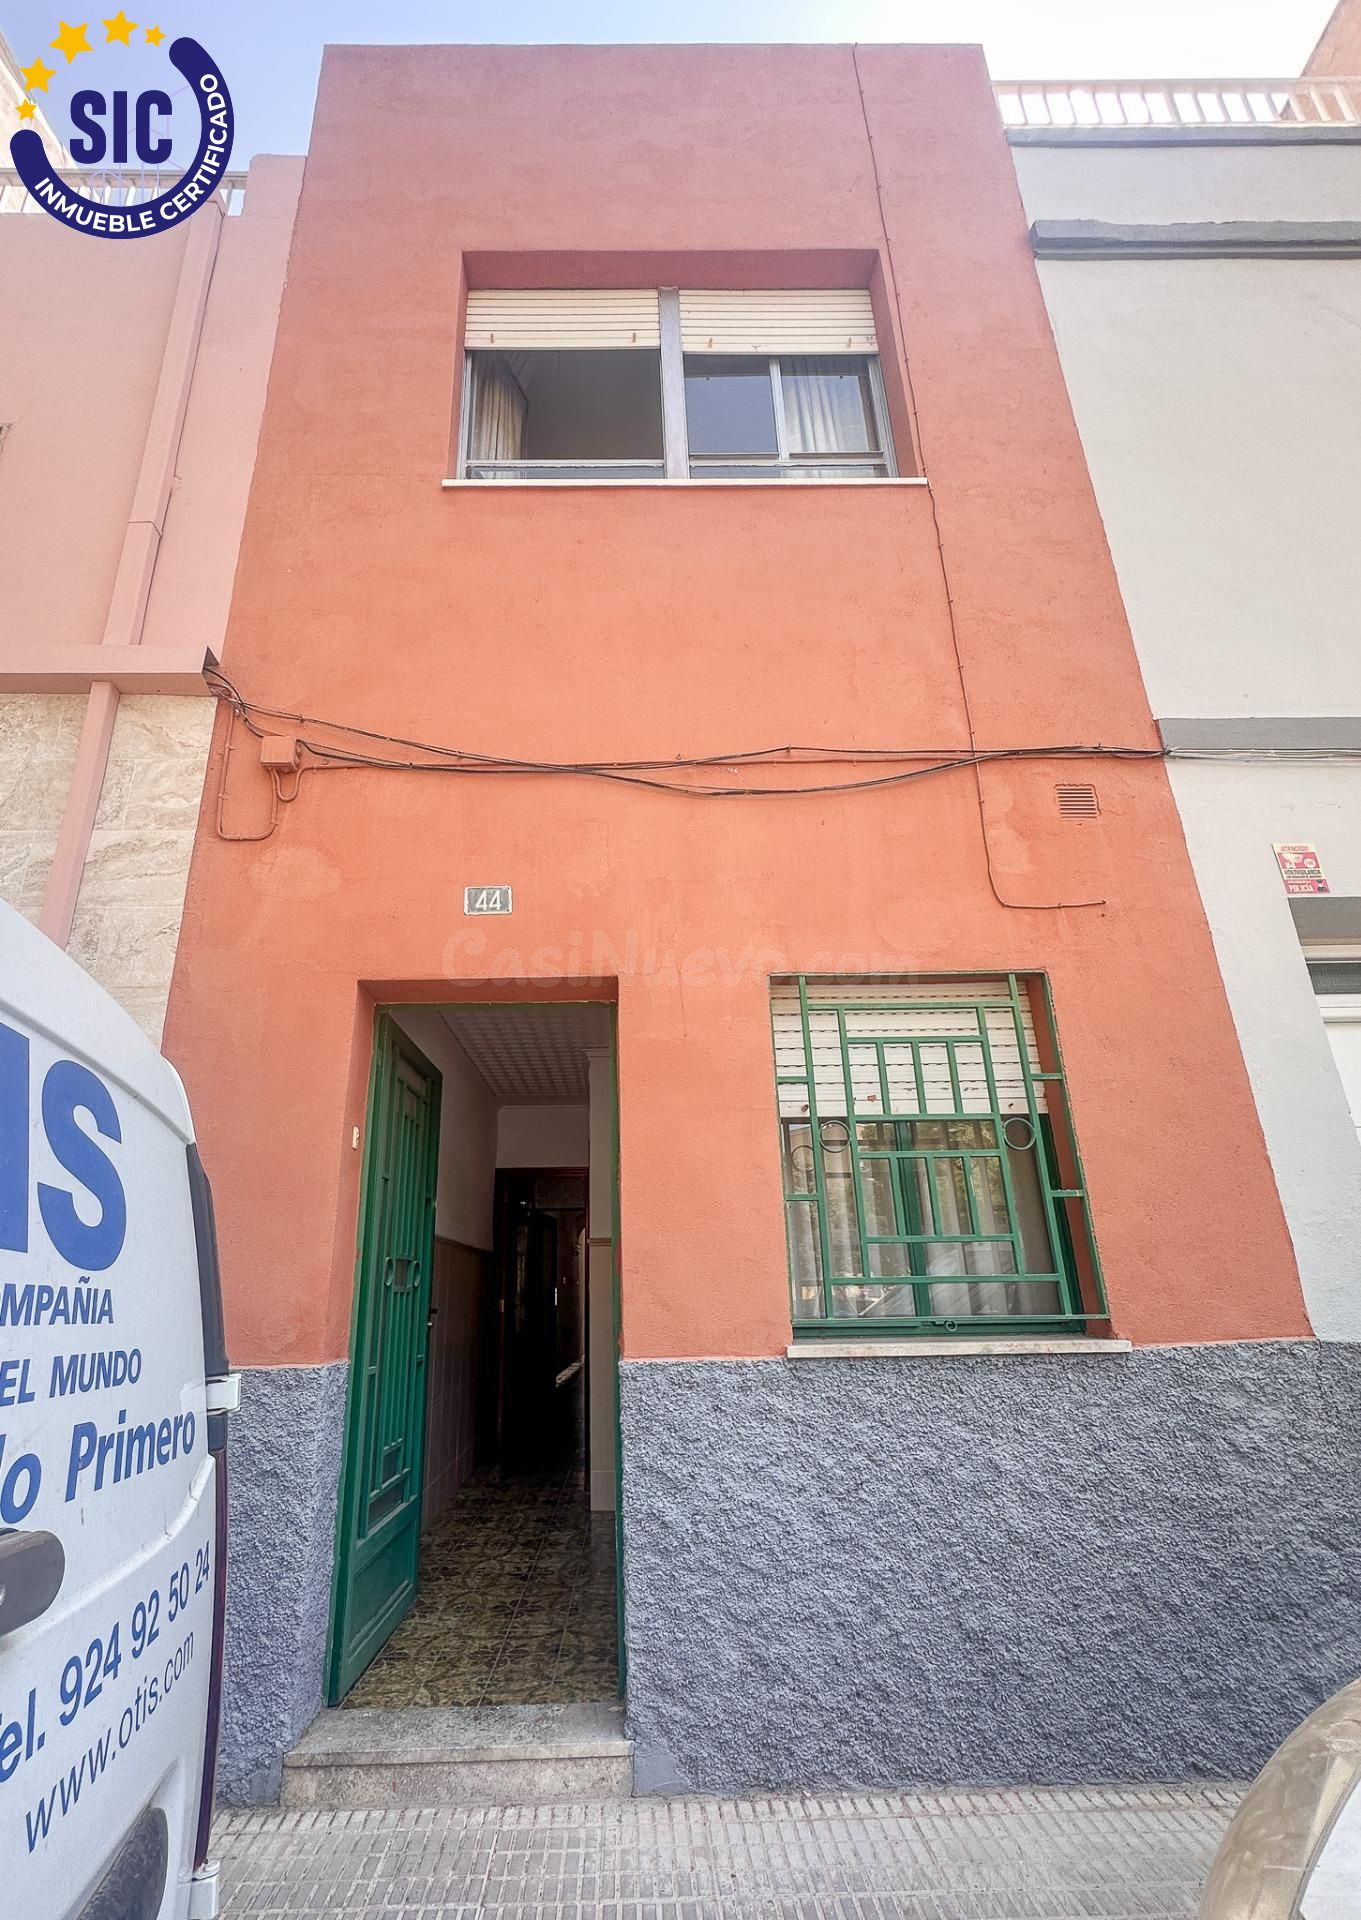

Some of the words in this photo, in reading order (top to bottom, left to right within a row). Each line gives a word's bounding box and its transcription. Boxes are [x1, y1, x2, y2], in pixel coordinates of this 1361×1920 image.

[475, 889, 502, 911] 44
[0, 1275, 114, 1327] MPAÑIA
[49, 1348, 142, 1399] MUNDO
[65, 1409, 196, 1503] Primero
[0, 1687, 46, 1783] el.
[59, 1622, 122, 1727] 924
[131, 1589, 160, 1660] 92
[168, 1562, 190, 1622] 50
[194, 1540, 210, 1595] 24
[25, 1631, 194, 1854] www.otis.com
